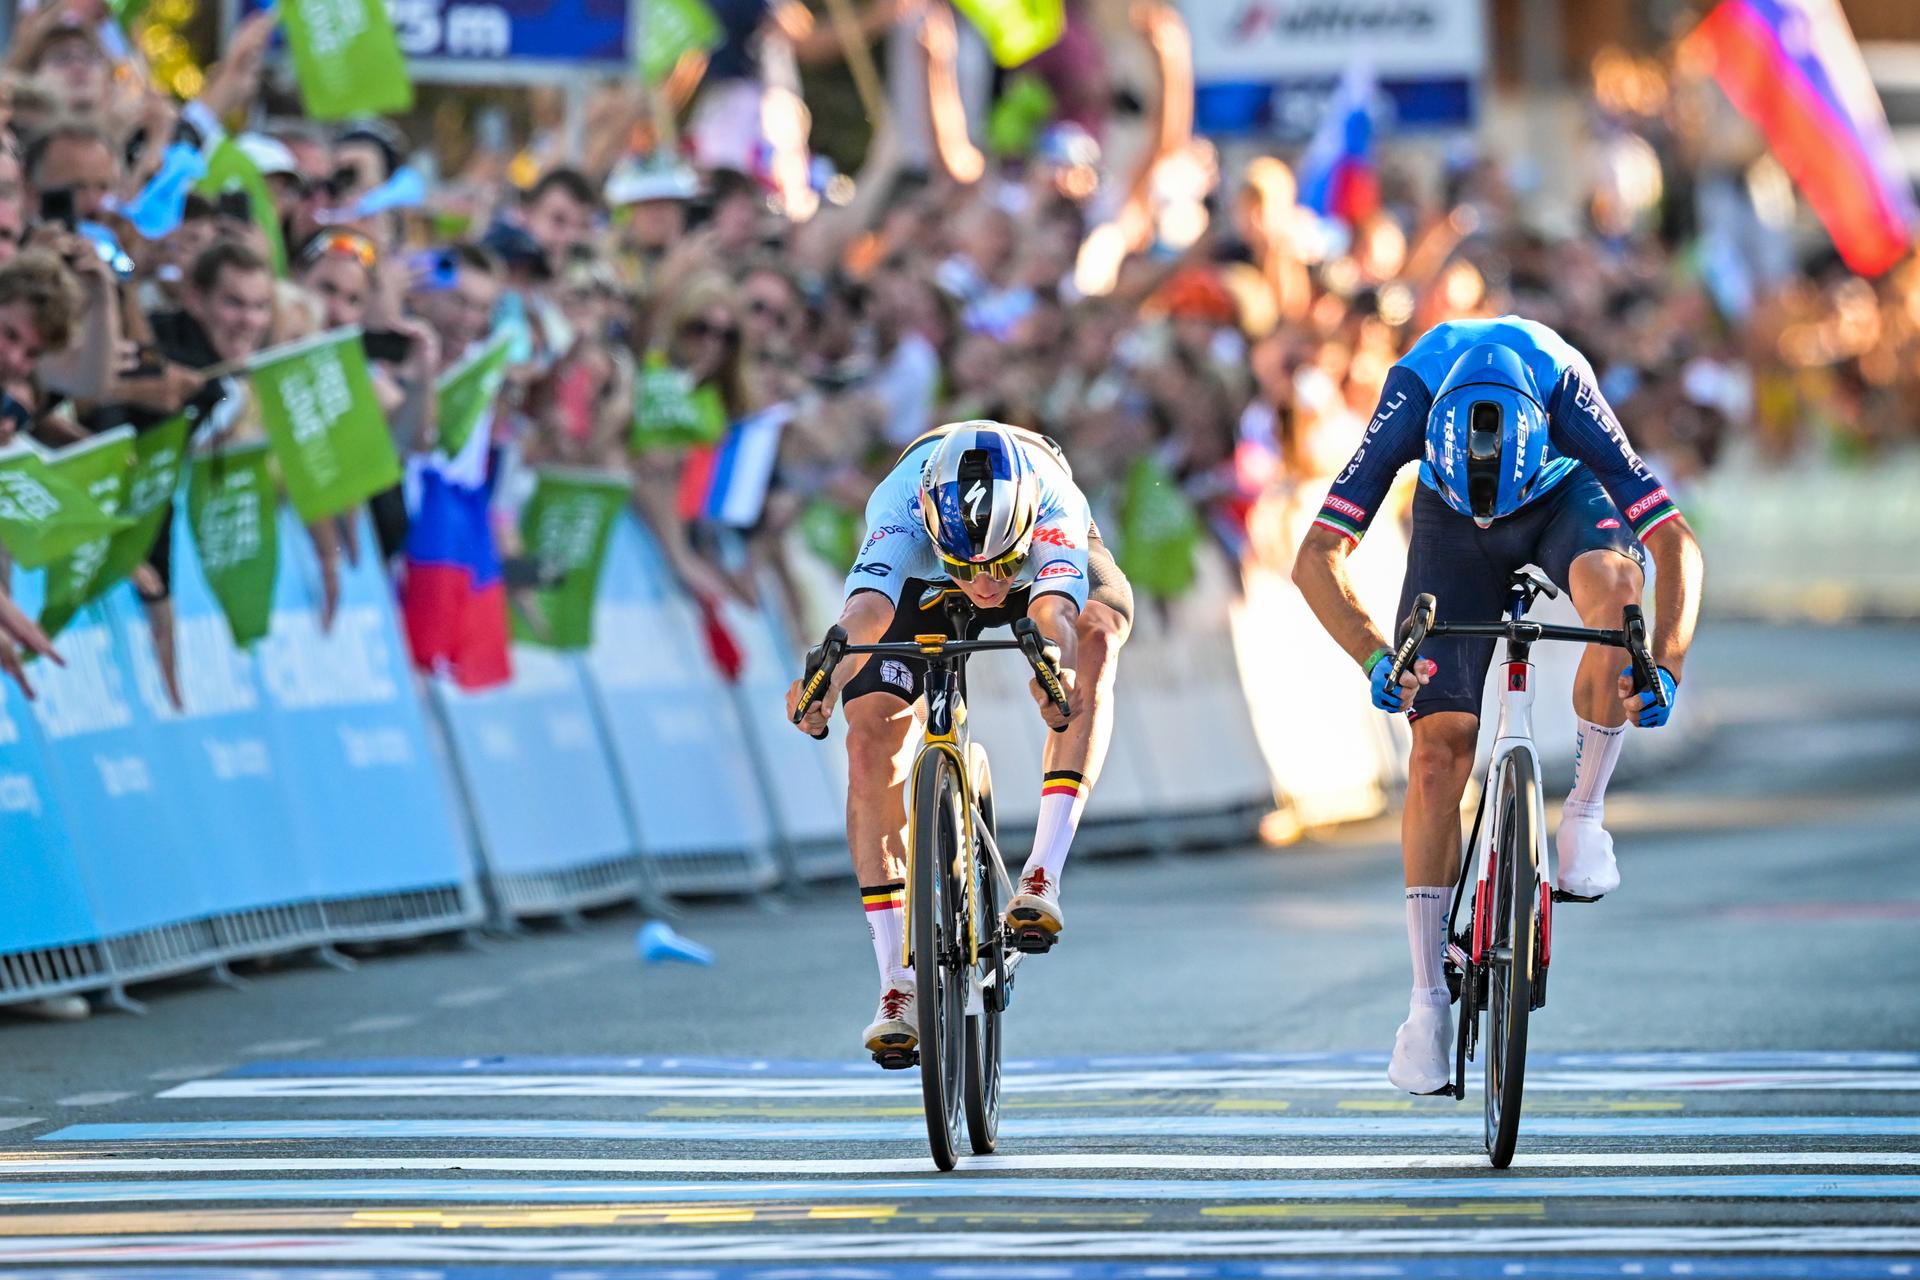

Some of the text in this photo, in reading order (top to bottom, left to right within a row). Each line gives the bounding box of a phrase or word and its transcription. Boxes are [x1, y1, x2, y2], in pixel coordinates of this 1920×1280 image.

[1336, 391, 1407, 484] CASTELLI
[1444, 406, 1456, 479] TREK
[1513, 409, 1529, 482] TREK
[1325, 496, 1366, 519] ENERVIT
[1642, 488, 1669, 511] ENER
[1389, 637, 1415, 682] SRAM
[798, 669, 826, 712] SRAM
[1036, 661, 1067, 704] SRAM
